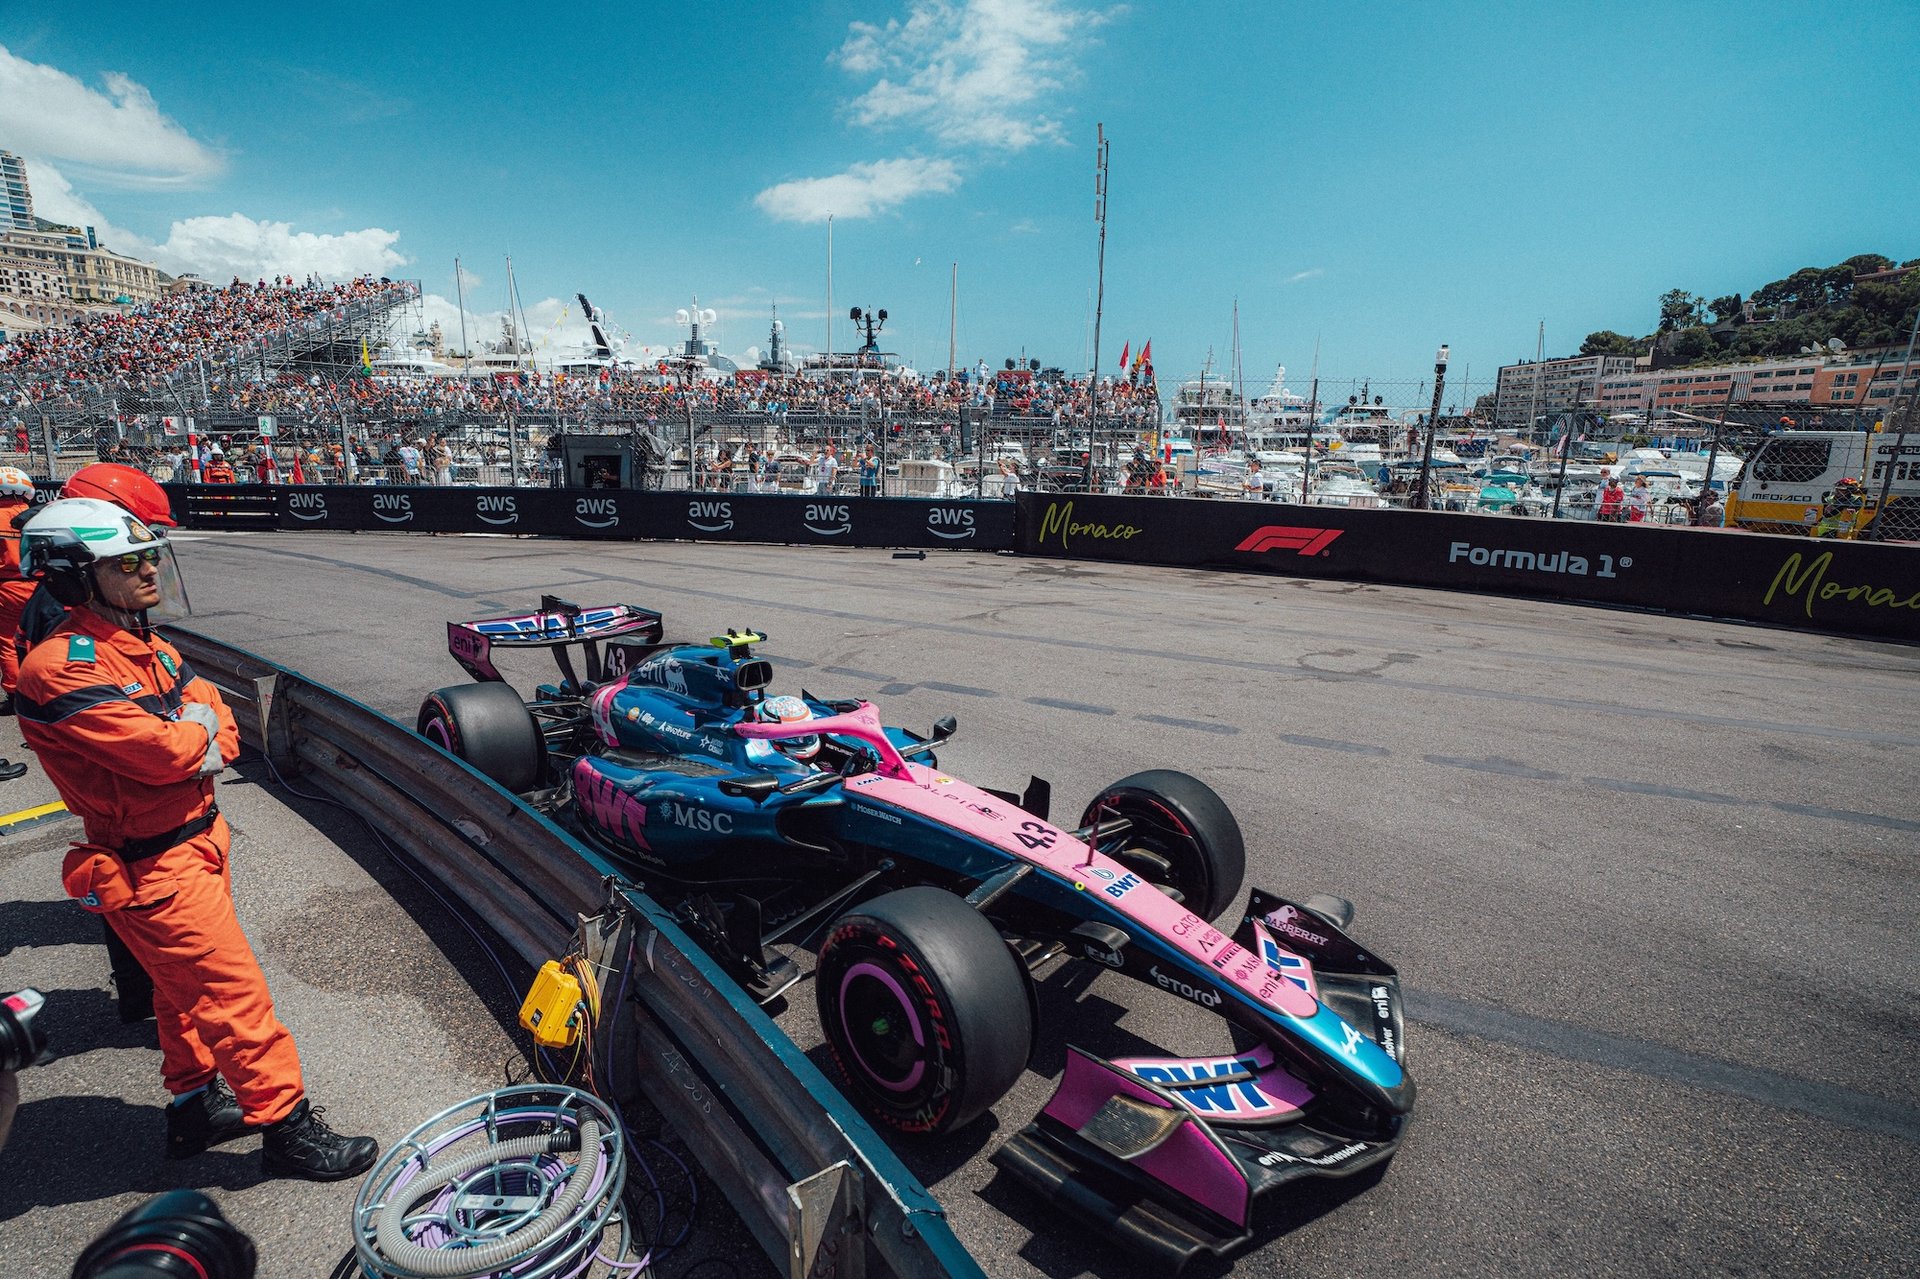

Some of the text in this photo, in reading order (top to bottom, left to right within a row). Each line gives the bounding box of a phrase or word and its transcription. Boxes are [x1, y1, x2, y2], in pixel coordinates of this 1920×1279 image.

[36, 488, 60, 503] aw
[289, 493, 325, 509] aws
[373, 494, 411, 510] aws
[477, 495, 516, 512] aws
[576, 498, 617, 514] aws
[689, 501, 732, 518] aws
[805, 504, 850, 521] aws
[929, 507, 975, 525] aws
[1039, 501, 1143, 549] Monaco
[1449, 542, 1588, 575] Formula
[454, 633, 471, 651] eni
[607, 647, 627, 677] 43
[574, 757, 652, 851] BWT
[916, 783, 1004, 821] ALPINE
[674, 802, 734, 834] MSC
[1012, 821, 1058, 850] 43
[1105, 873, 1141, 899] BWT
[1172, 914, 1200, 936] CATO
[1264, 915, 1329, 946] OAKBERRY
[1259, 975, 1279, 999] eni
[1373, 1000, 1390, 1019] eni
